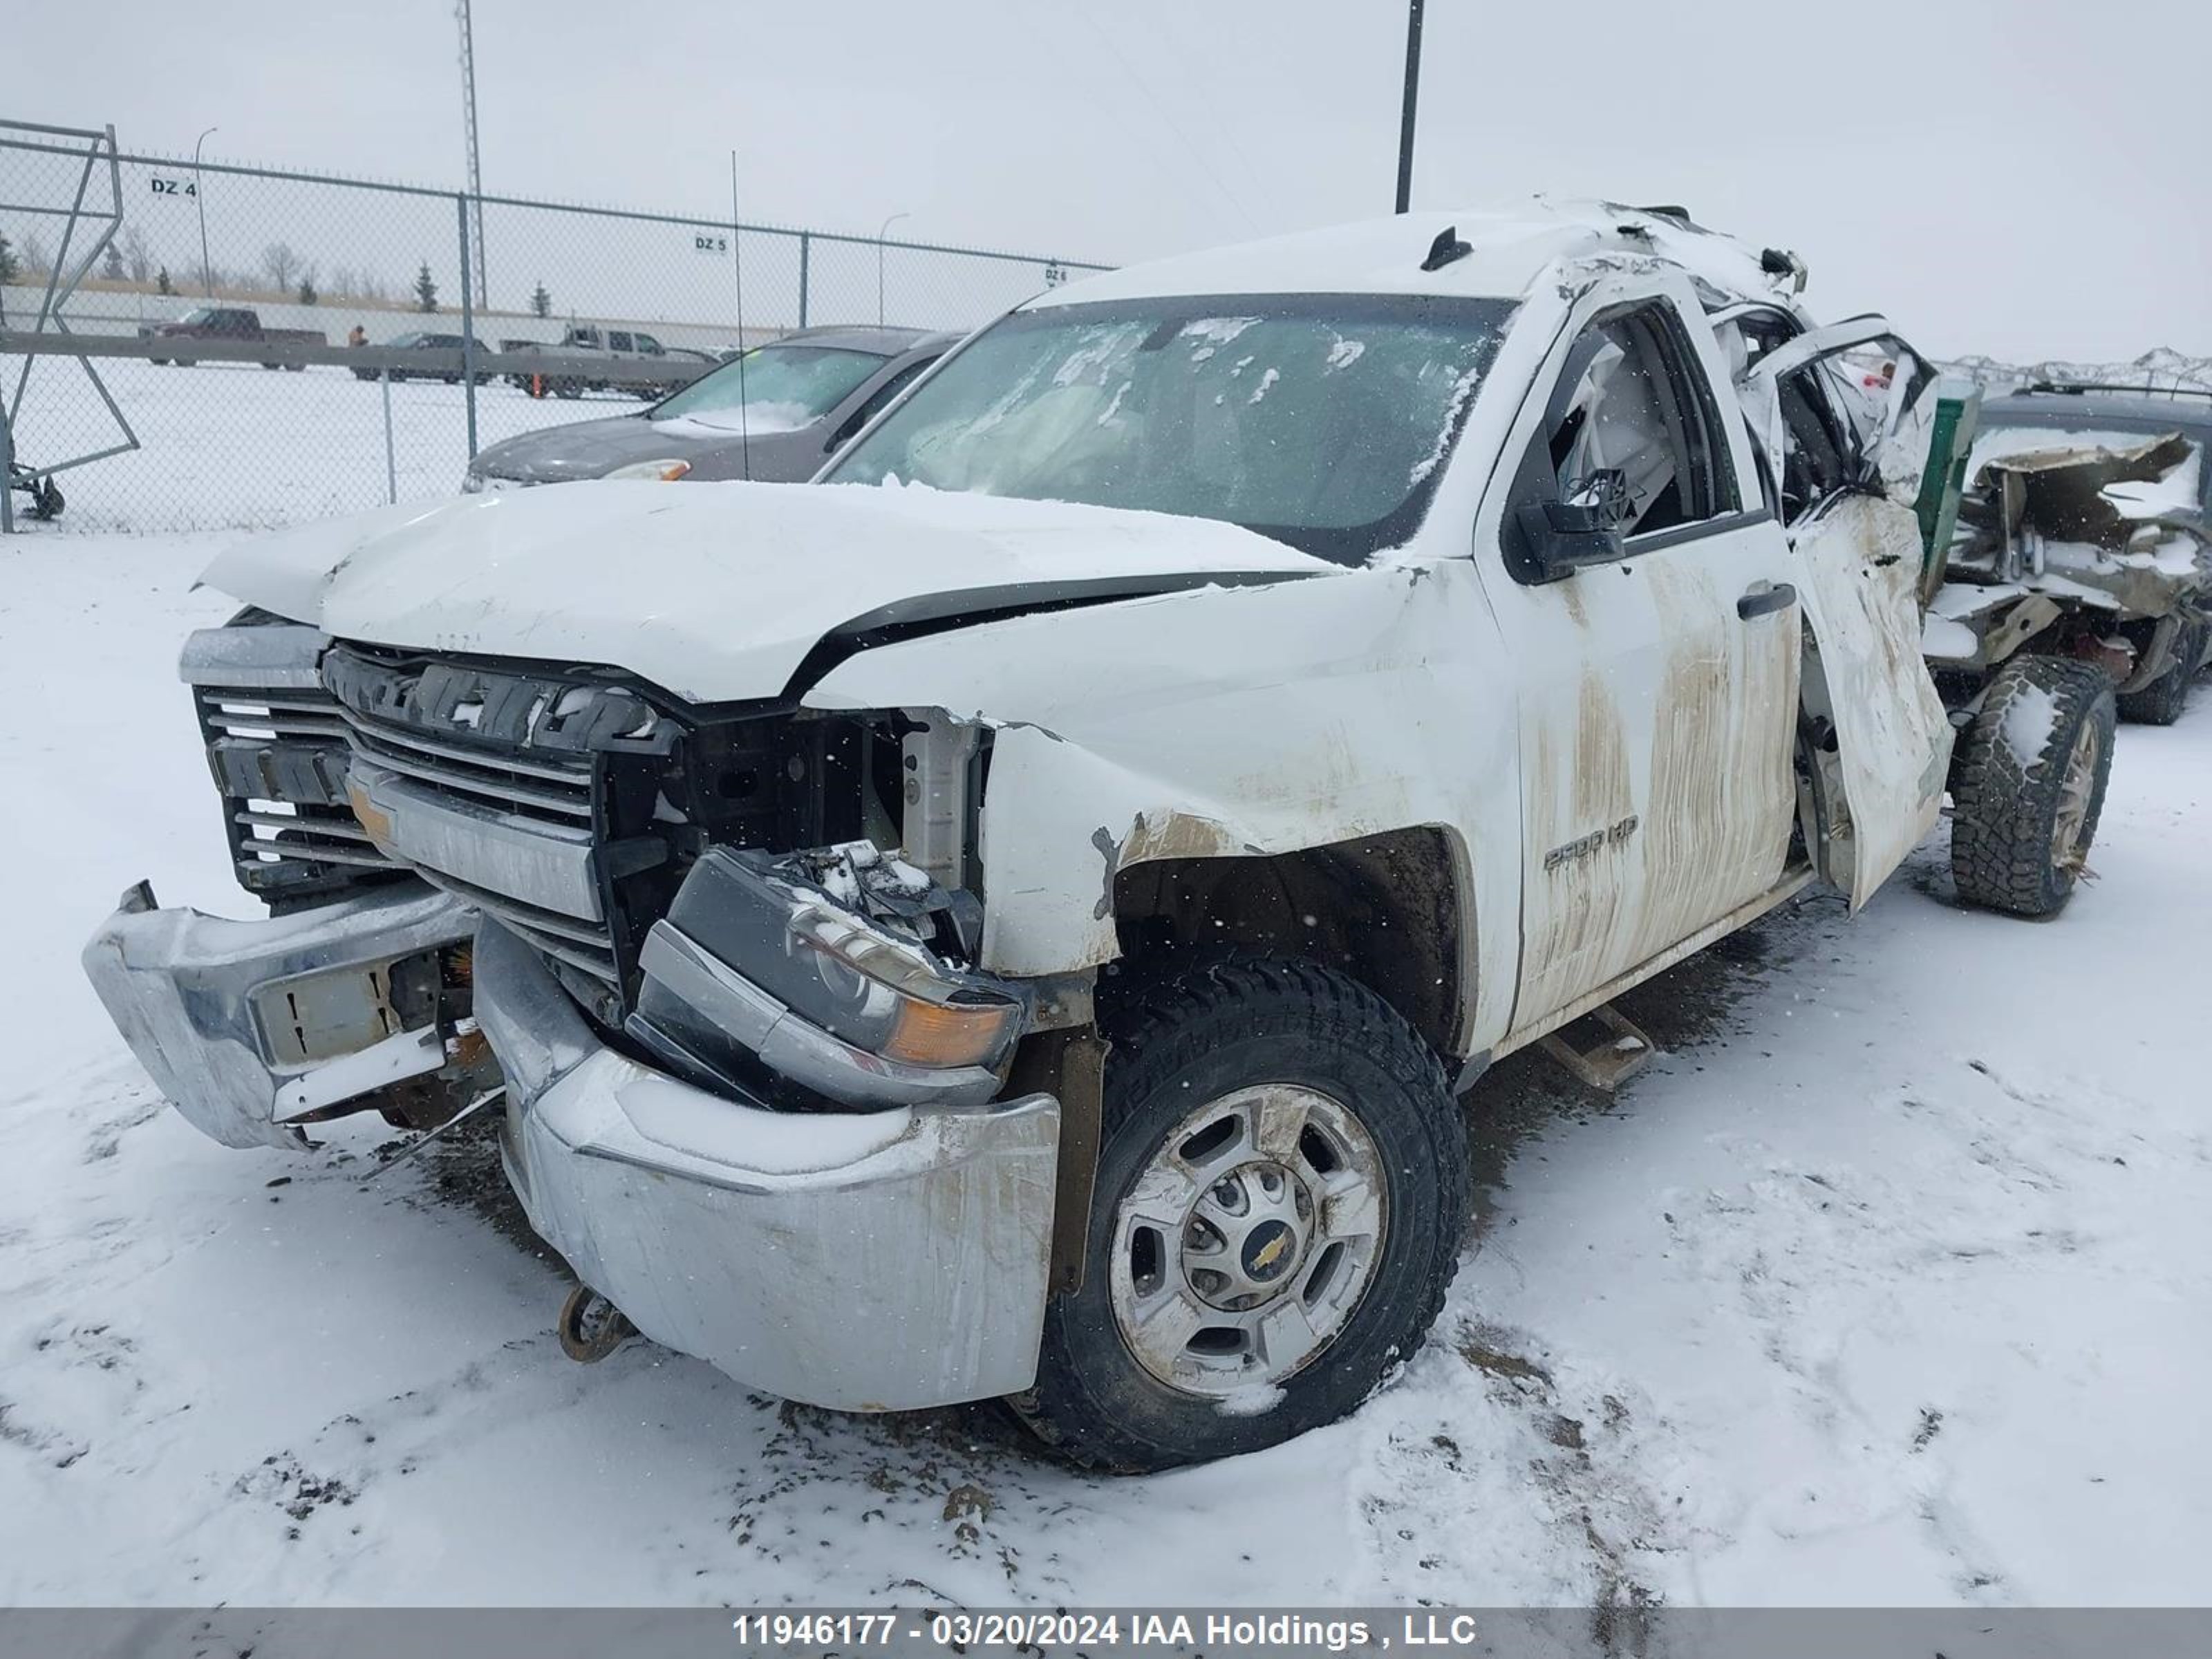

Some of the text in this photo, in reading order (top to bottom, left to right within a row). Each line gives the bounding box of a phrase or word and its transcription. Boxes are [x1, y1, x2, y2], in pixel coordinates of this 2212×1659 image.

[151, 179, 196, 197] DZ 4
[696, 237, 726, 251] DZ 5
[1046, 269, 1058, 280] DZ
